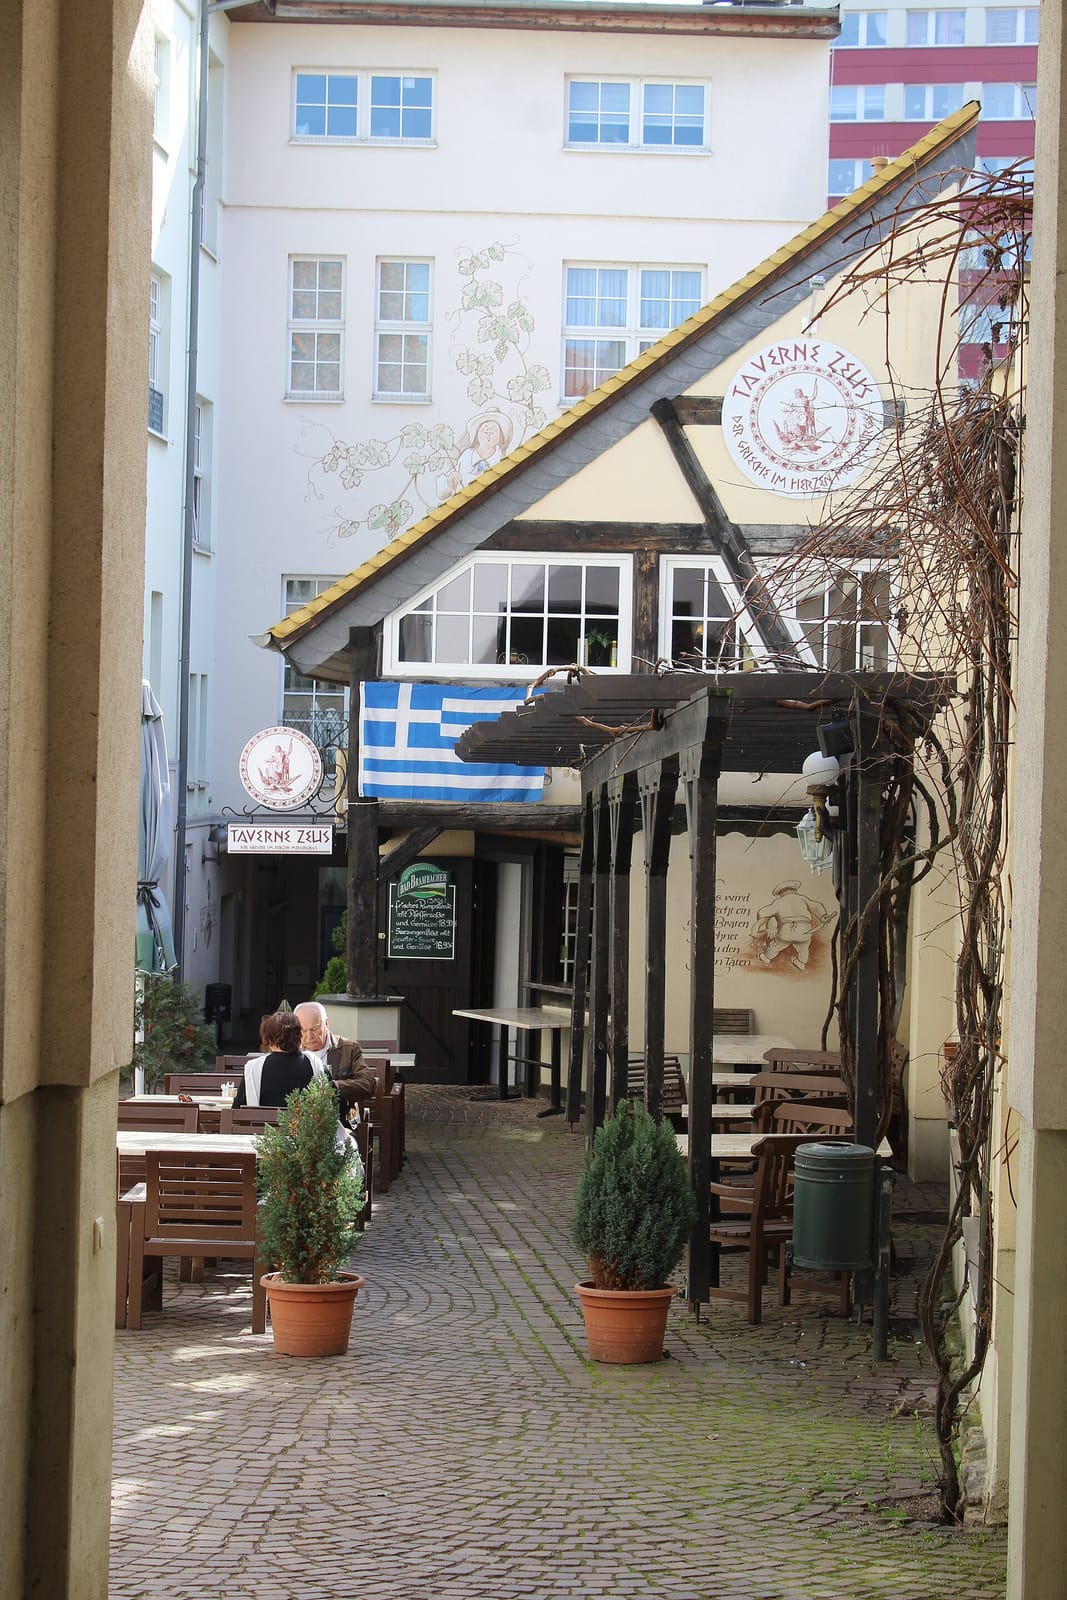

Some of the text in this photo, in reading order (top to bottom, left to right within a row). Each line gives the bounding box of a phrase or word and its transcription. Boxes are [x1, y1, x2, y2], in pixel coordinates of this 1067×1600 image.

[732, 343, 874, 400] TAVERNE ZEUS
[731, 415, 743, 438] DER
[737, 440, 772, 480] GRIECHE
[770, 472, 786, 489] IM
[230, 828, 330, 844] TAVERNE ZEUS
[724, 892, 751, 902] wird
[715, 905, 734, 916] echt
[714, 917, 749, 928] Braten
